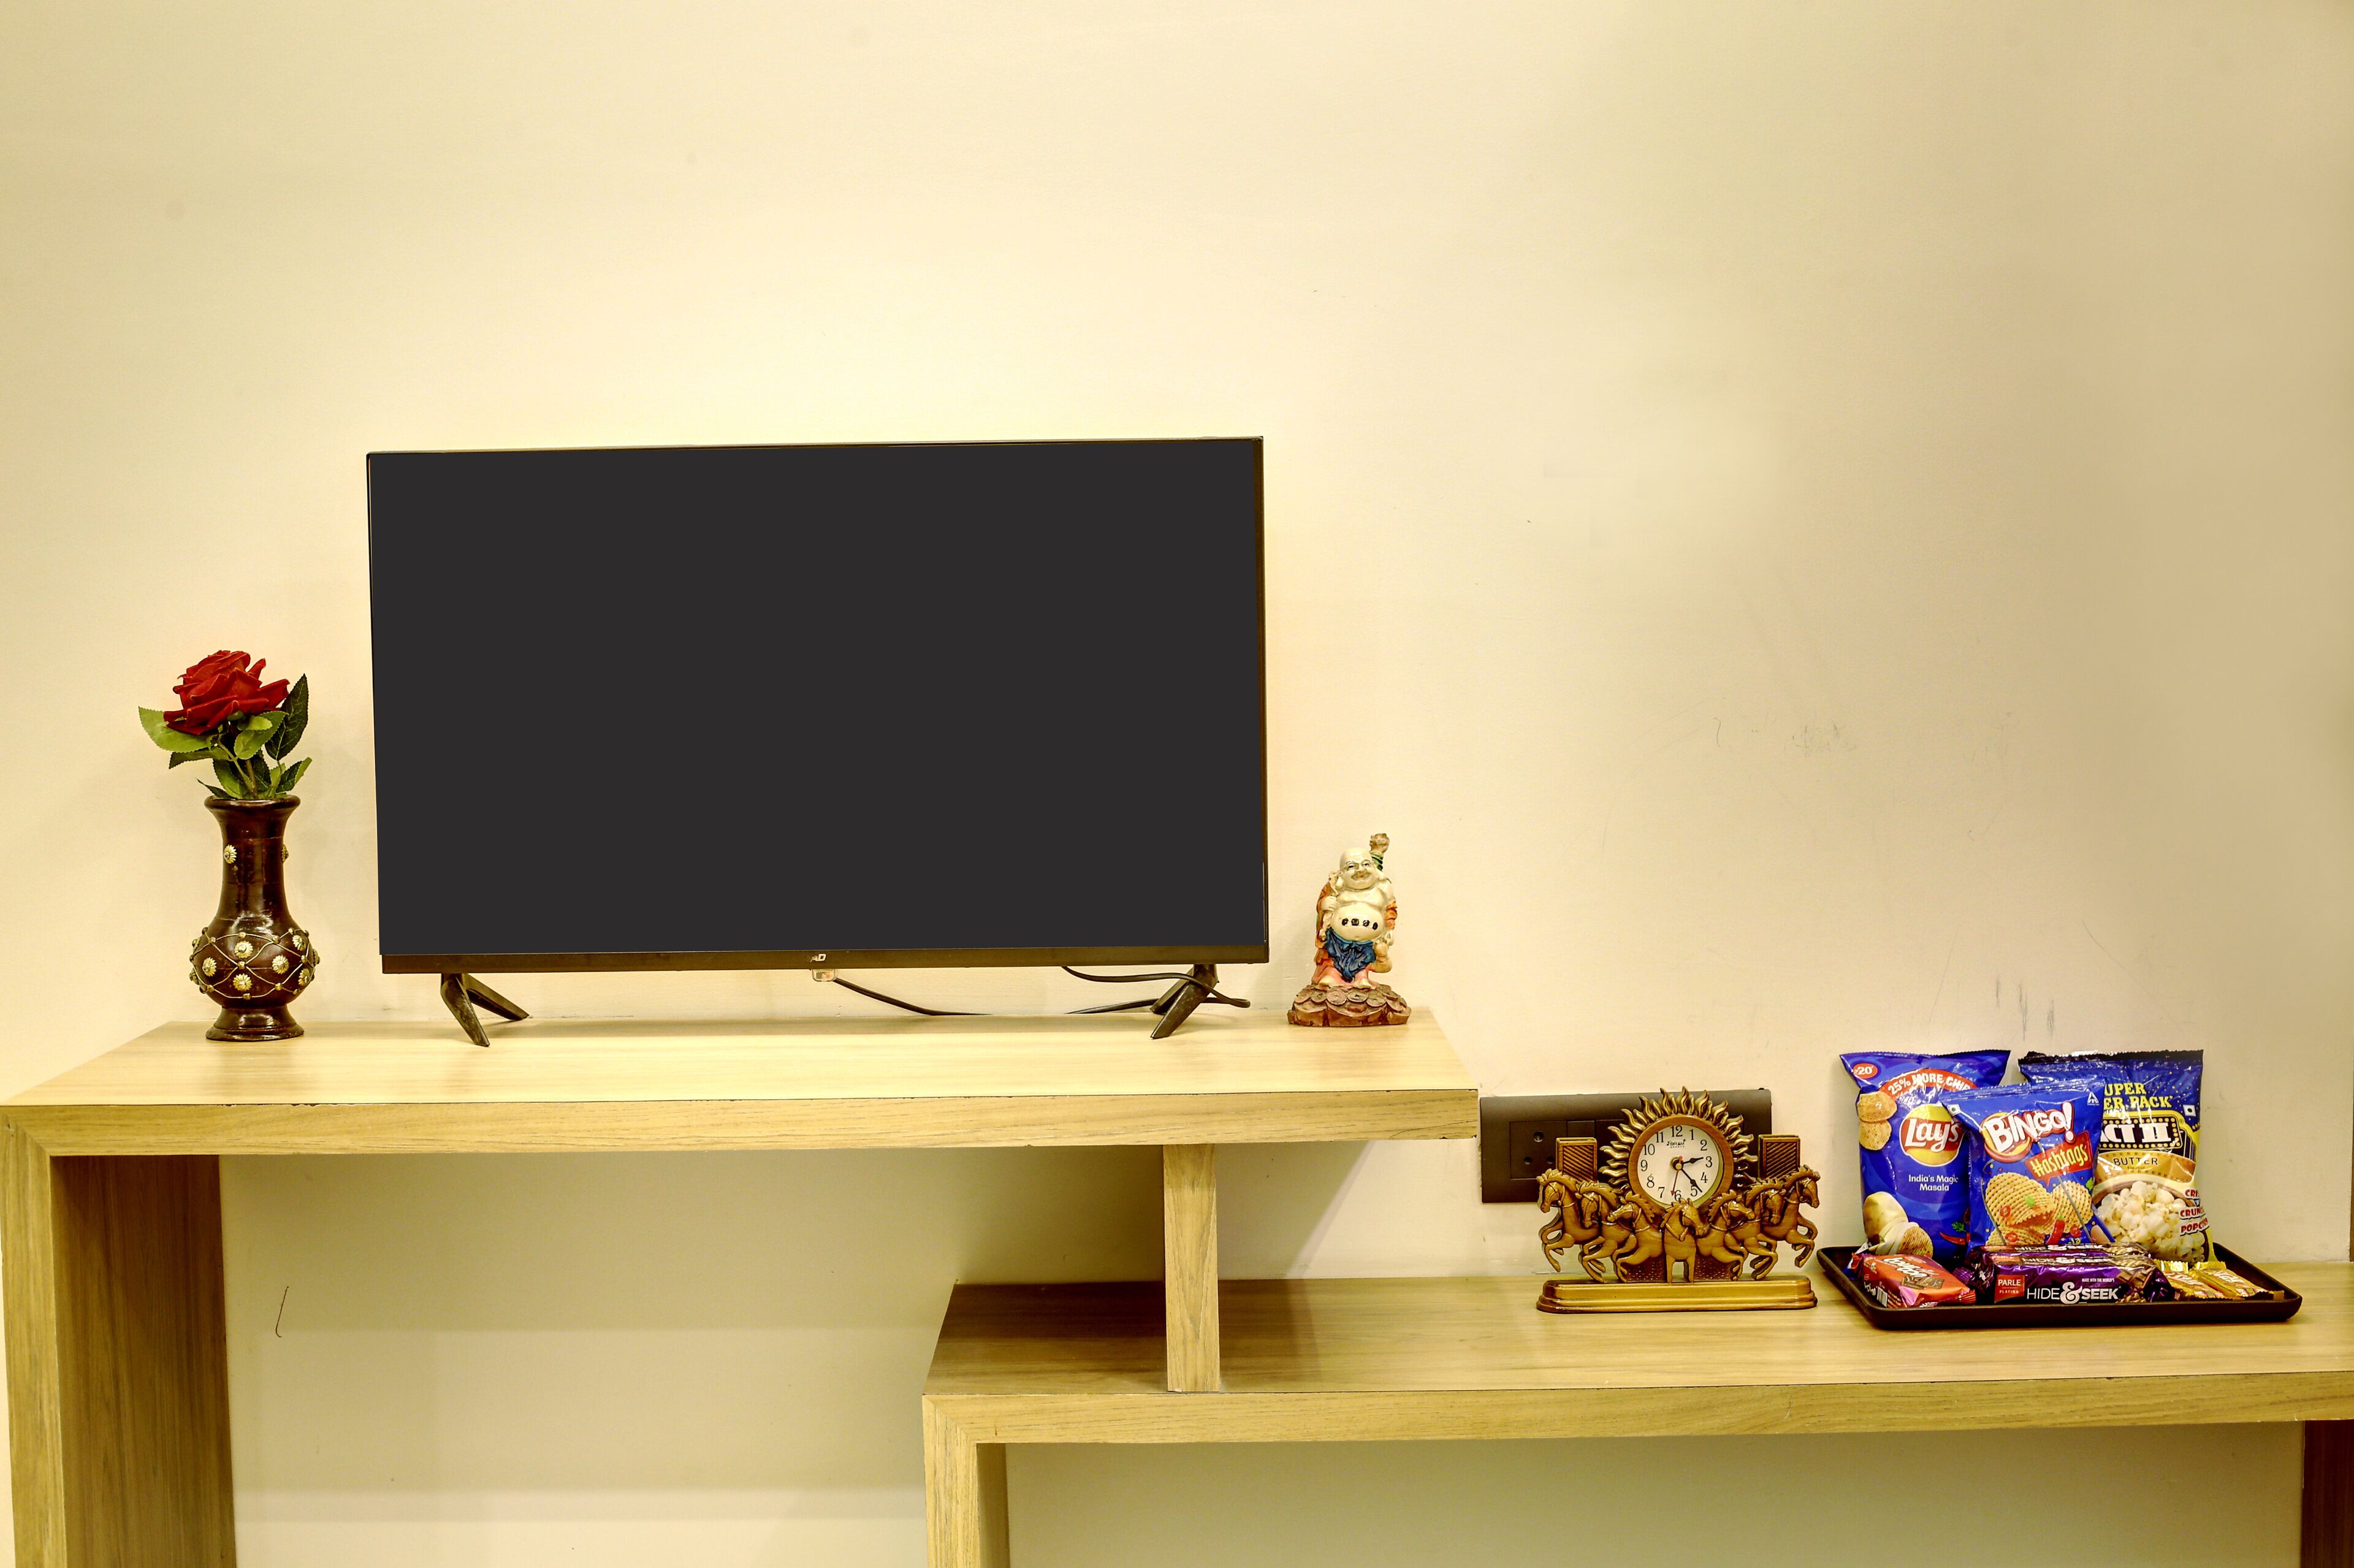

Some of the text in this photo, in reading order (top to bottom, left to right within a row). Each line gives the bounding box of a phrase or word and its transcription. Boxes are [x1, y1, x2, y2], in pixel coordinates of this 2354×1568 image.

[1887, 1073, 1971, 1095] 25% MORE CHIP
[2104, 1083, 2147, 1097] UPER
[2103, 1096, 2126, 1110] ER
[1671, 1125, 1683, 1137] 12
[1984, 1102, 2075, 1152] BINGO!
[1656, 1132, 1664, 1143] 11
[1689, 1129, 1694, 1140] 1
[1644, 1144, 1655, 1155] 10
[1700, 1140, 1707, 1151] 2
[1640, 1160, 1648, 1171] 9
[1705, 1156, 1713, 1168] 3
[2030, 1144, 2089, 1177] Hashtags
[2113, 1157, 2158, 1165] BUTTER
[1647, 1174, 1655, 1188] 8
[1701, 1172, 1708, 1183] 4
[1936, 1174, 1959, 1184] Magic
[1658, 1187, 1665, 1198] 7
[1674, 1190, 1682, 1201] 6
[1690, 1186, 1698, 1197] 5
[2027, 1282, 2119, 1304] HIDE & SEEK
